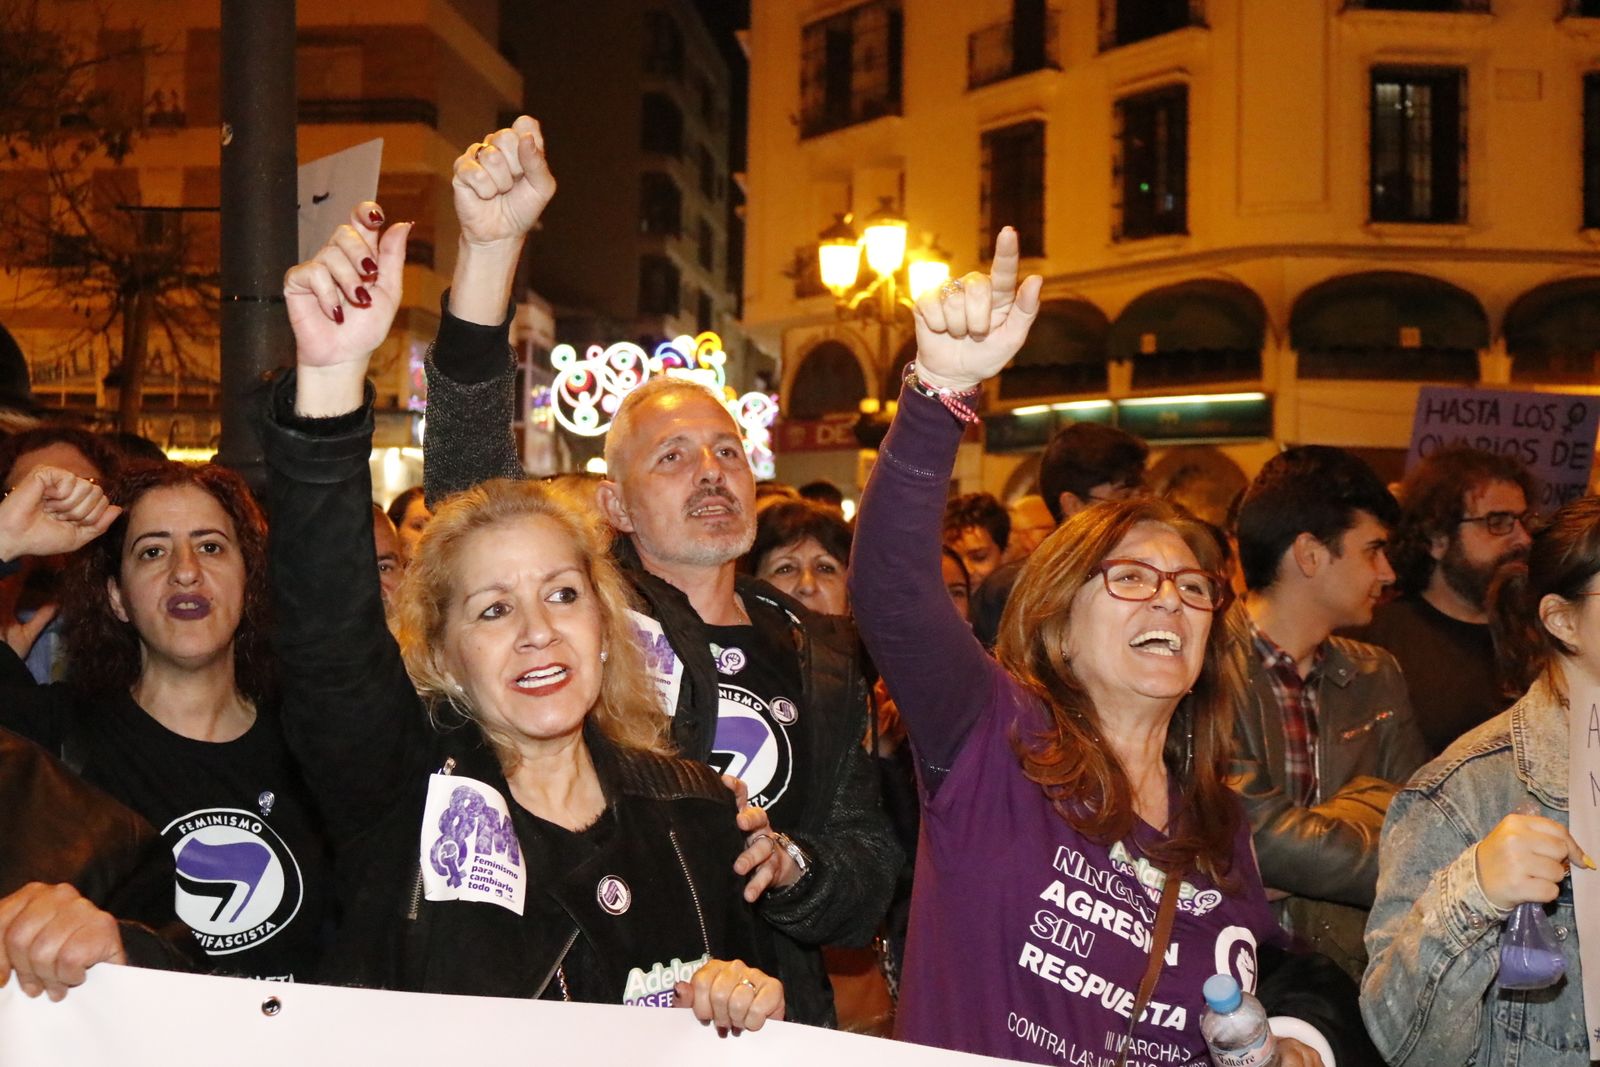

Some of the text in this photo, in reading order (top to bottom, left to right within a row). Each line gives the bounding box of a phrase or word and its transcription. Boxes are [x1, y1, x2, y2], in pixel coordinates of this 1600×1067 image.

[1425, 398, 1558, 432] HASTA LOS
[1551, 440, 1590, 471] DE
[178, 815, 263, 836] FEMINISMO
[471, 865, 494, 876] para
[474, 855, 518, 879] Feminismo
[1112, 860, 1135, 877] LAS
[467, 881, 490, 892] todo
[469, 873, 513, 893] cambiarlo
[191, 921, 277, 949] TIFASCISTA
[1029, 910, 1095, 958] SIN
[1039, 879, 1179, 966] AGRESIN
[1007, 1012, 1066, 1059] CONTRA
